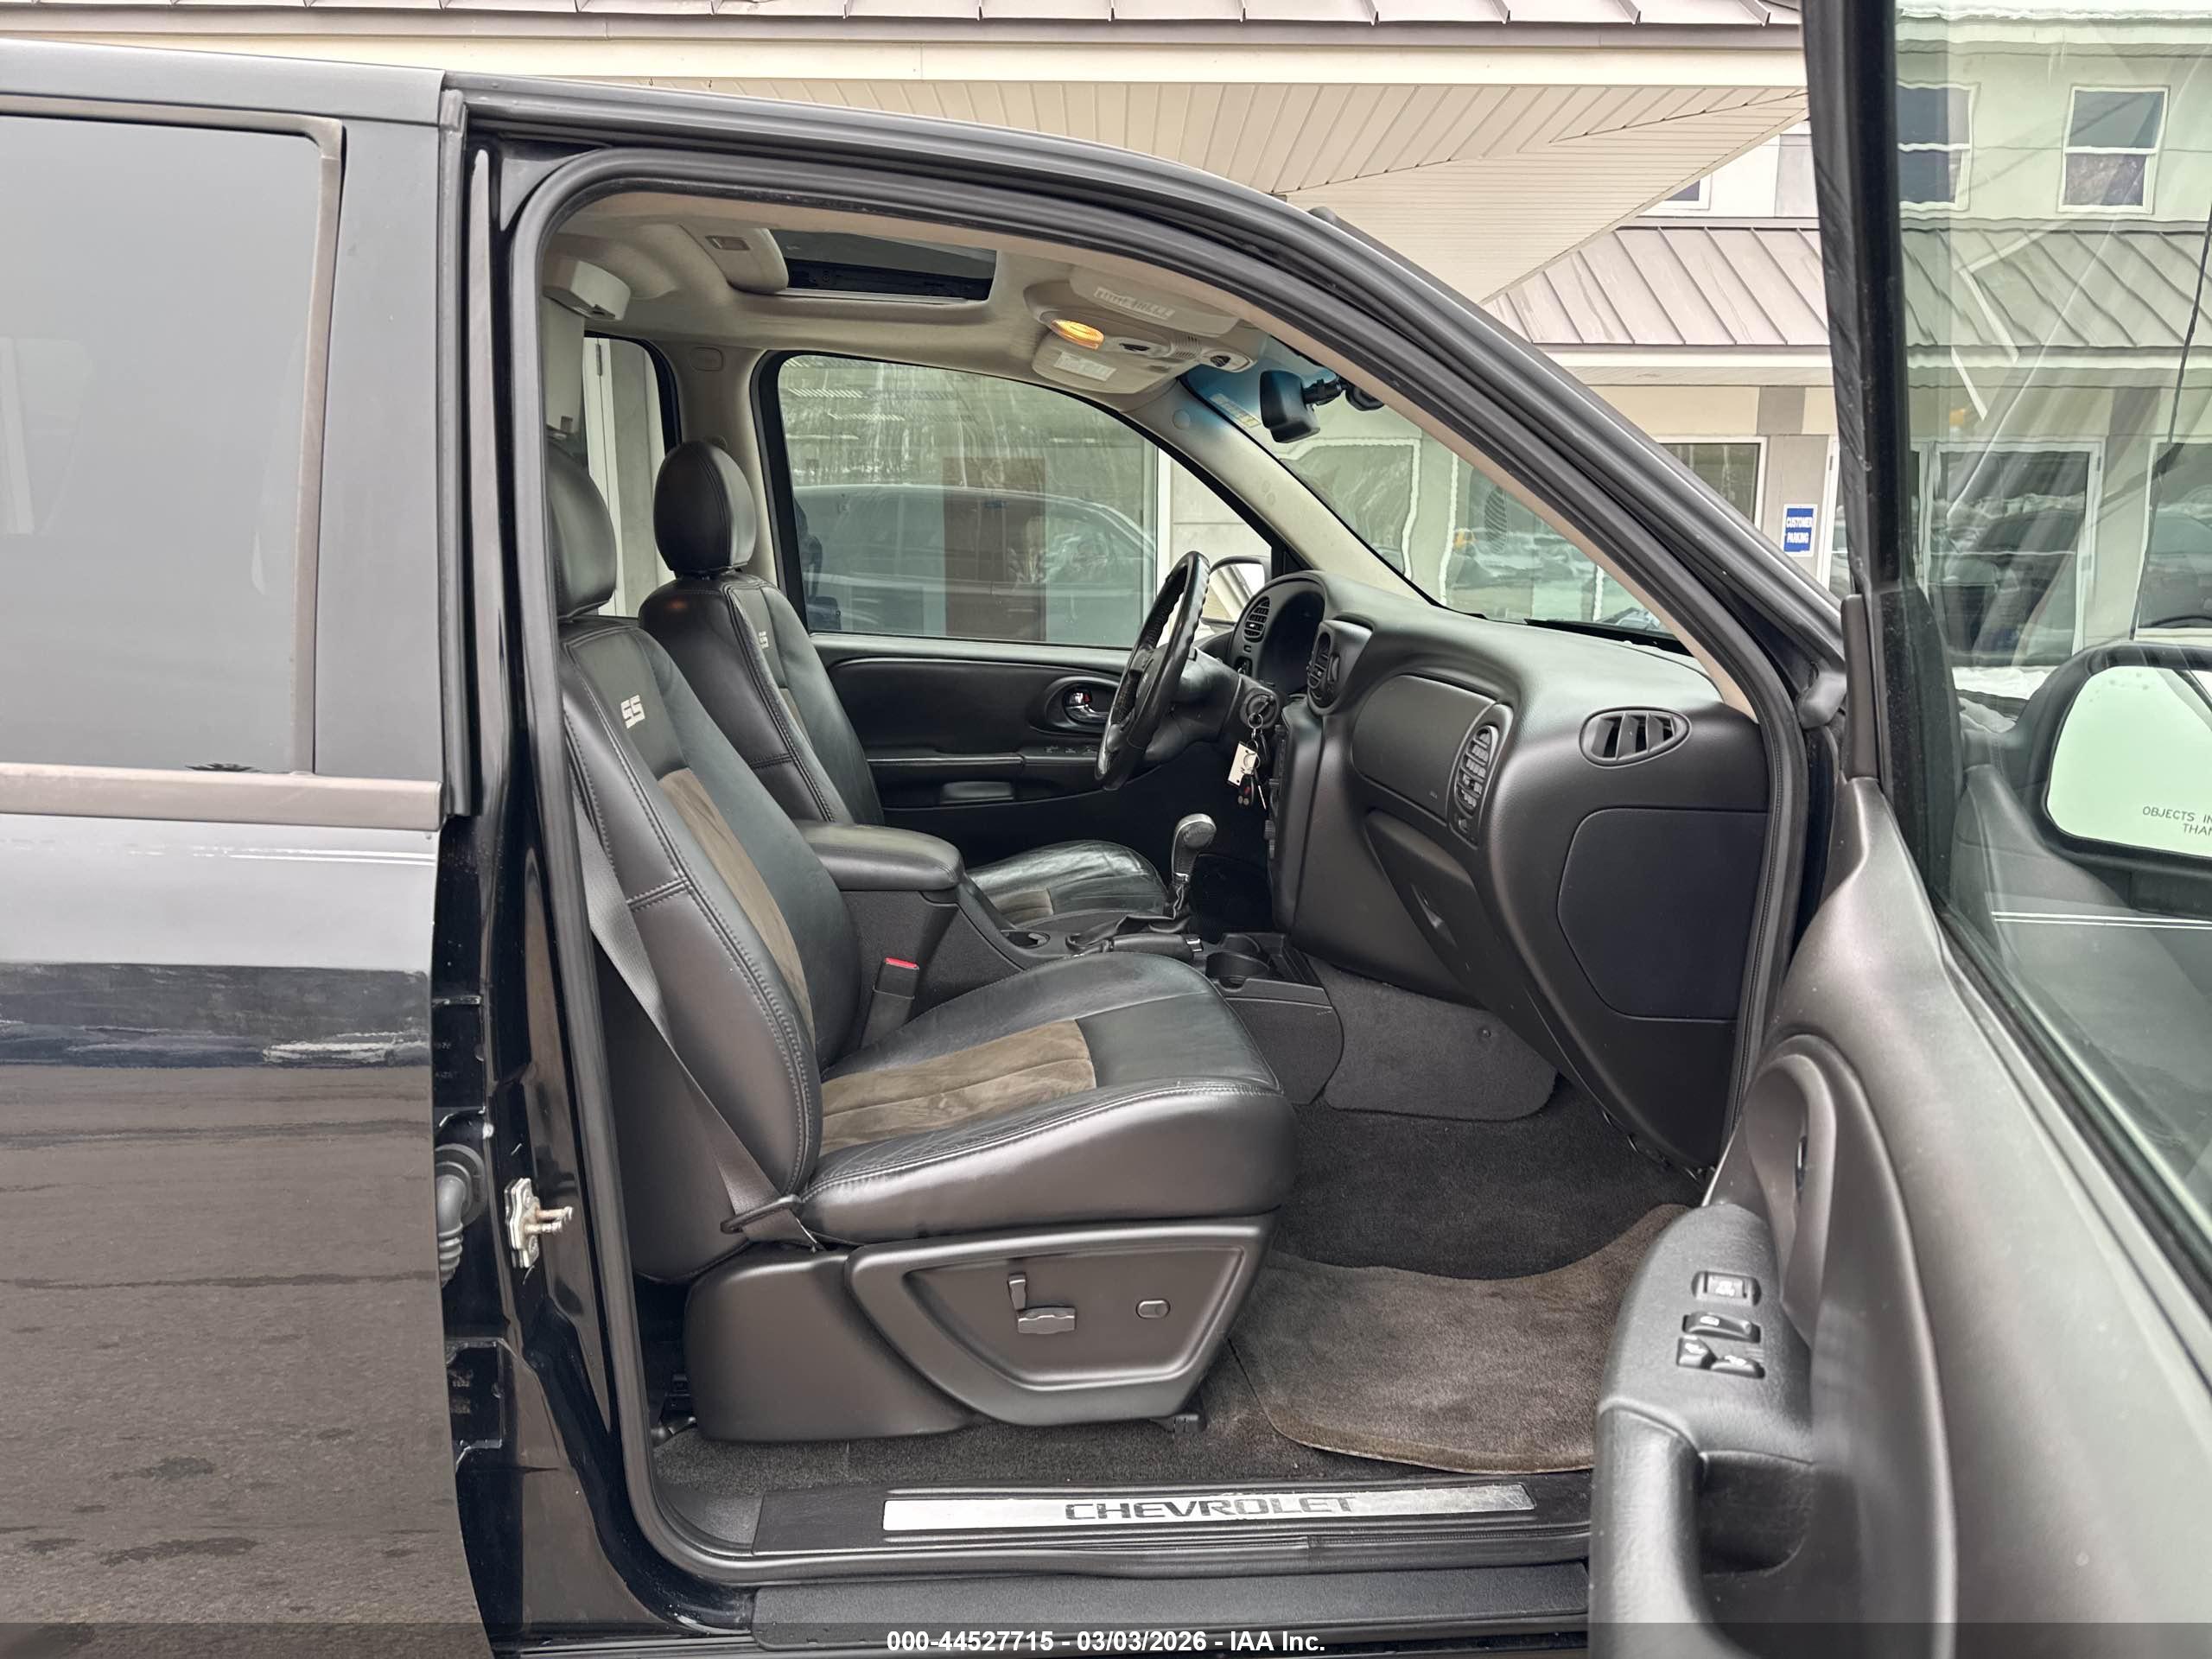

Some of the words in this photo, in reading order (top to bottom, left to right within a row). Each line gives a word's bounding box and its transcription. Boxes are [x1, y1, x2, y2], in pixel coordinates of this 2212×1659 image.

[1786, 532, 1809, 543] PARKING
[620, 694, 645, 729] SS
[2142, 805, 2196, 822] OBJECTS
[1065, 1496, 1356, 1520] CHEVROLET
